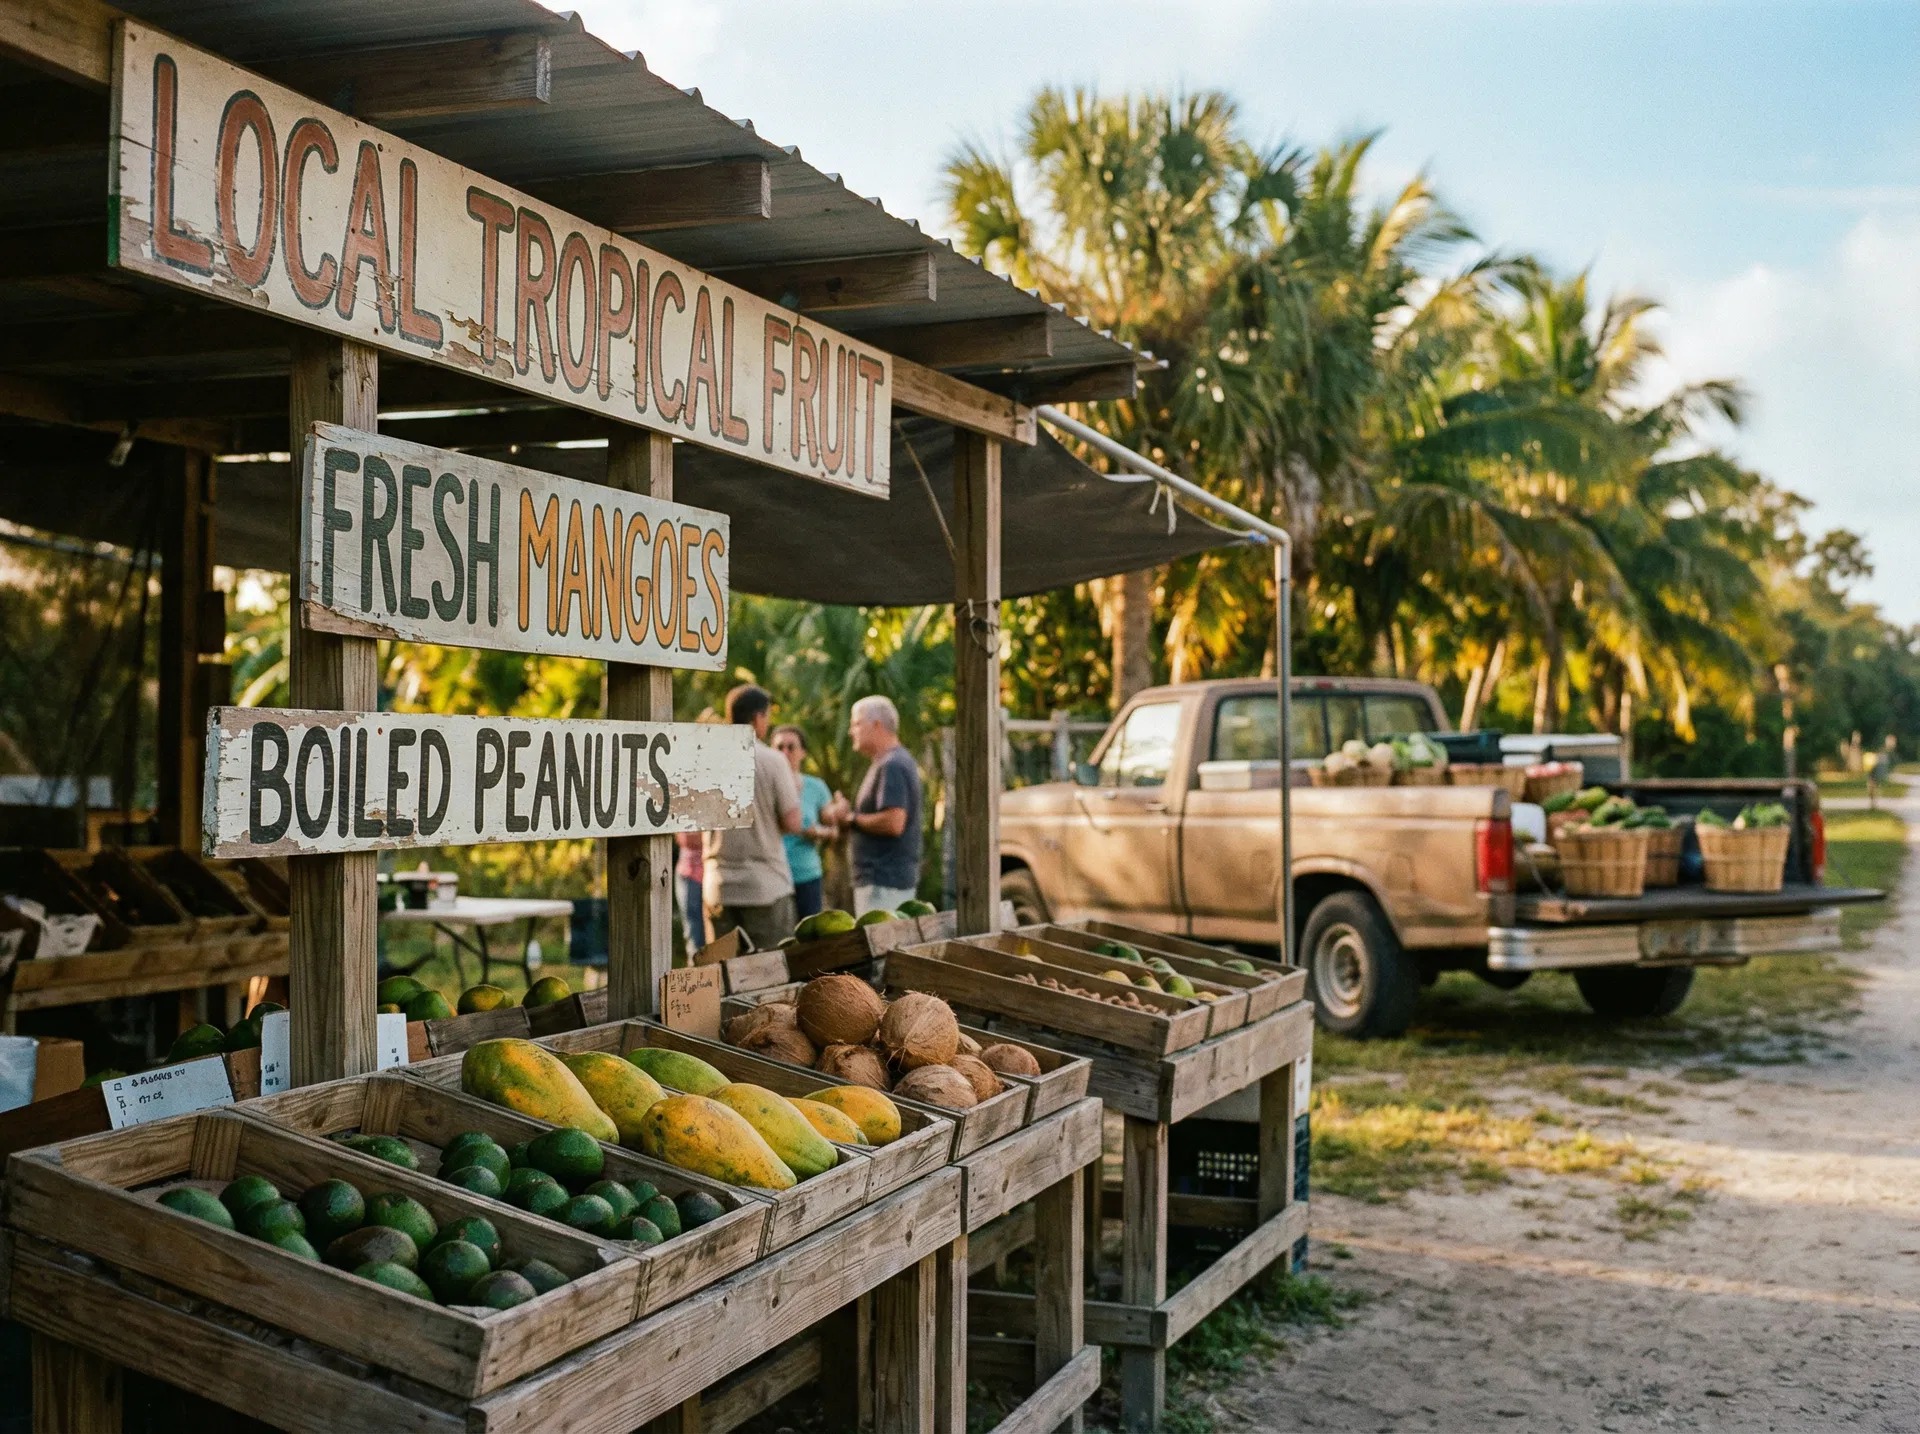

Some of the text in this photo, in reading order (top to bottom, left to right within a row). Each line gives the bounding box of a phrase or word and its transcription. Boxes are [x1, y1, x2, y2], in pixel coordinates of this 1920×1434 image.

[150, 52, 885, 484] LOCAL TROPICAL FRUIT
[321, 447, 725, 656] FRESH MANGOES
[249, 721, 672, 844] BOILED PEANUTS
